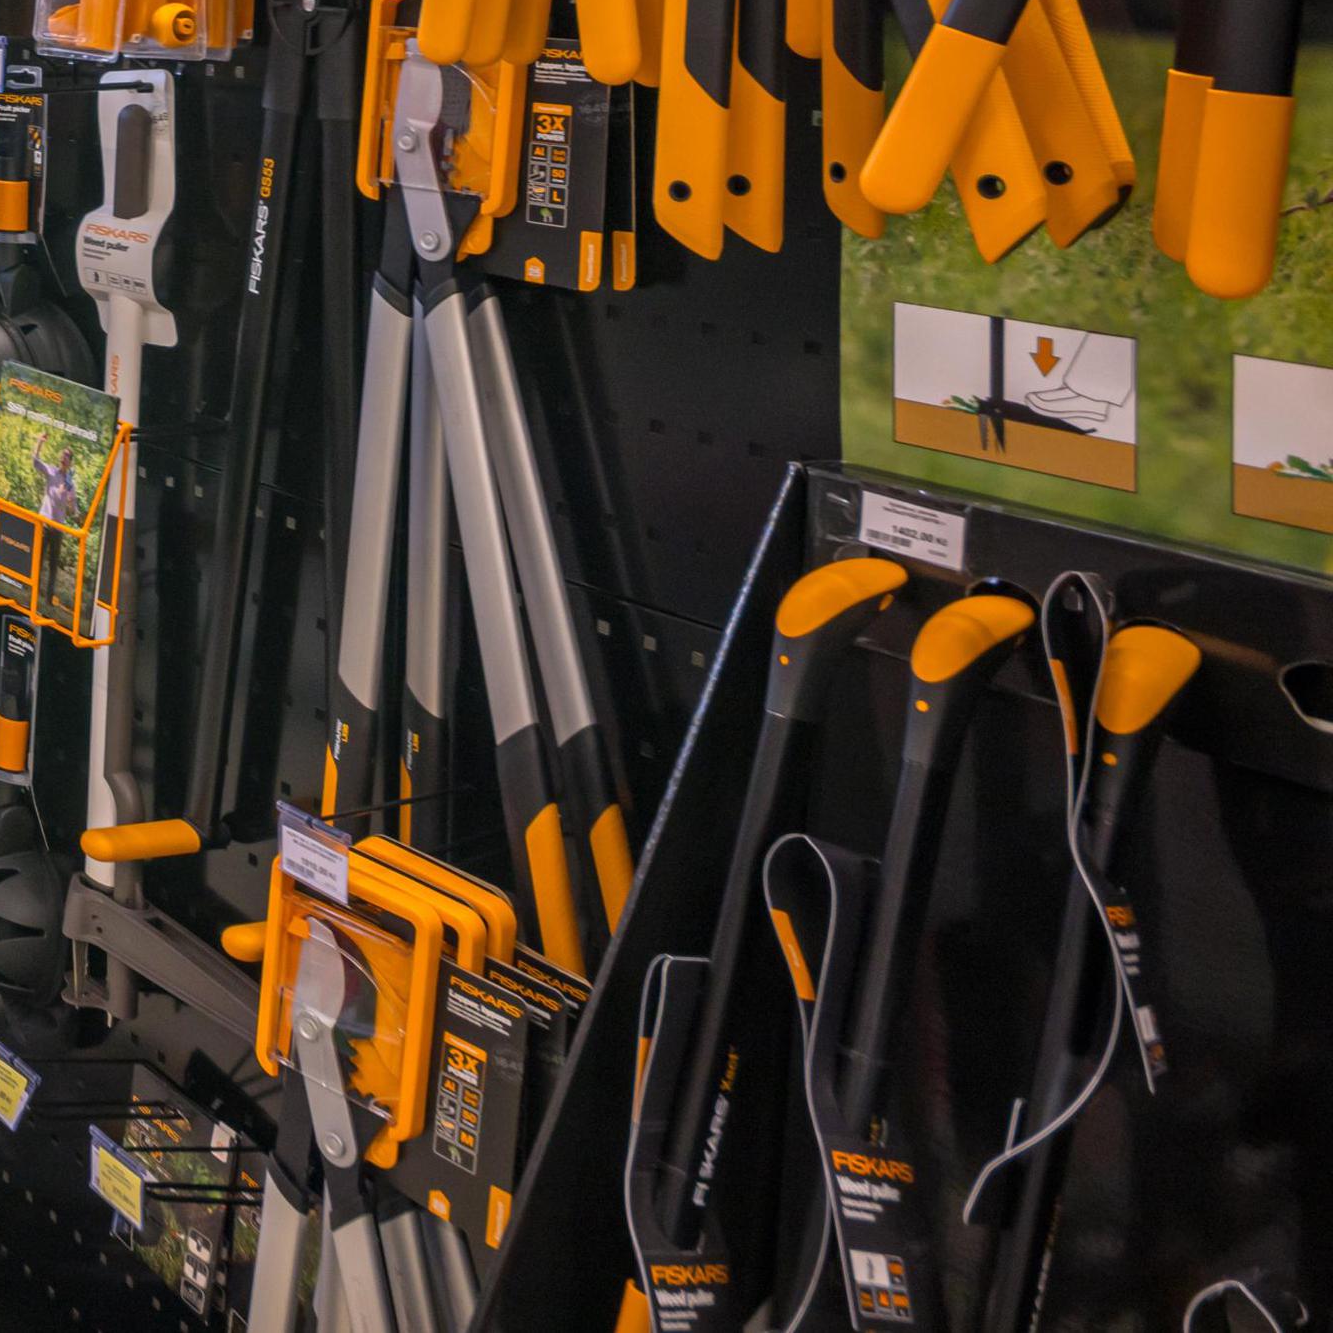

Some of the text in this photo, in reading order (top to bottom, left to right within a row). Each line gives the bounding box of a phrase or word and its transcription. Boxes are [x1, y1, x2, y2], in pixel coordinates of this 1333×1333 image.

[536, 115, 565, 134] 3X
[536, 132, 565, 142] POWER
[85, 223, 150, 244] FISKARS
[248, 205, 270, 294] FISKARS
[449, 975, 522, 1018] FISKARS
[489, 970, 561, 1012] FISKARS
[517, 960, 589, 1002] FISKARS
[447, 1048, 479, 1075] 3X
[831, 1149, 915, 1184] FISKARS
[650, 1263, 730, 1285] FISKARS
